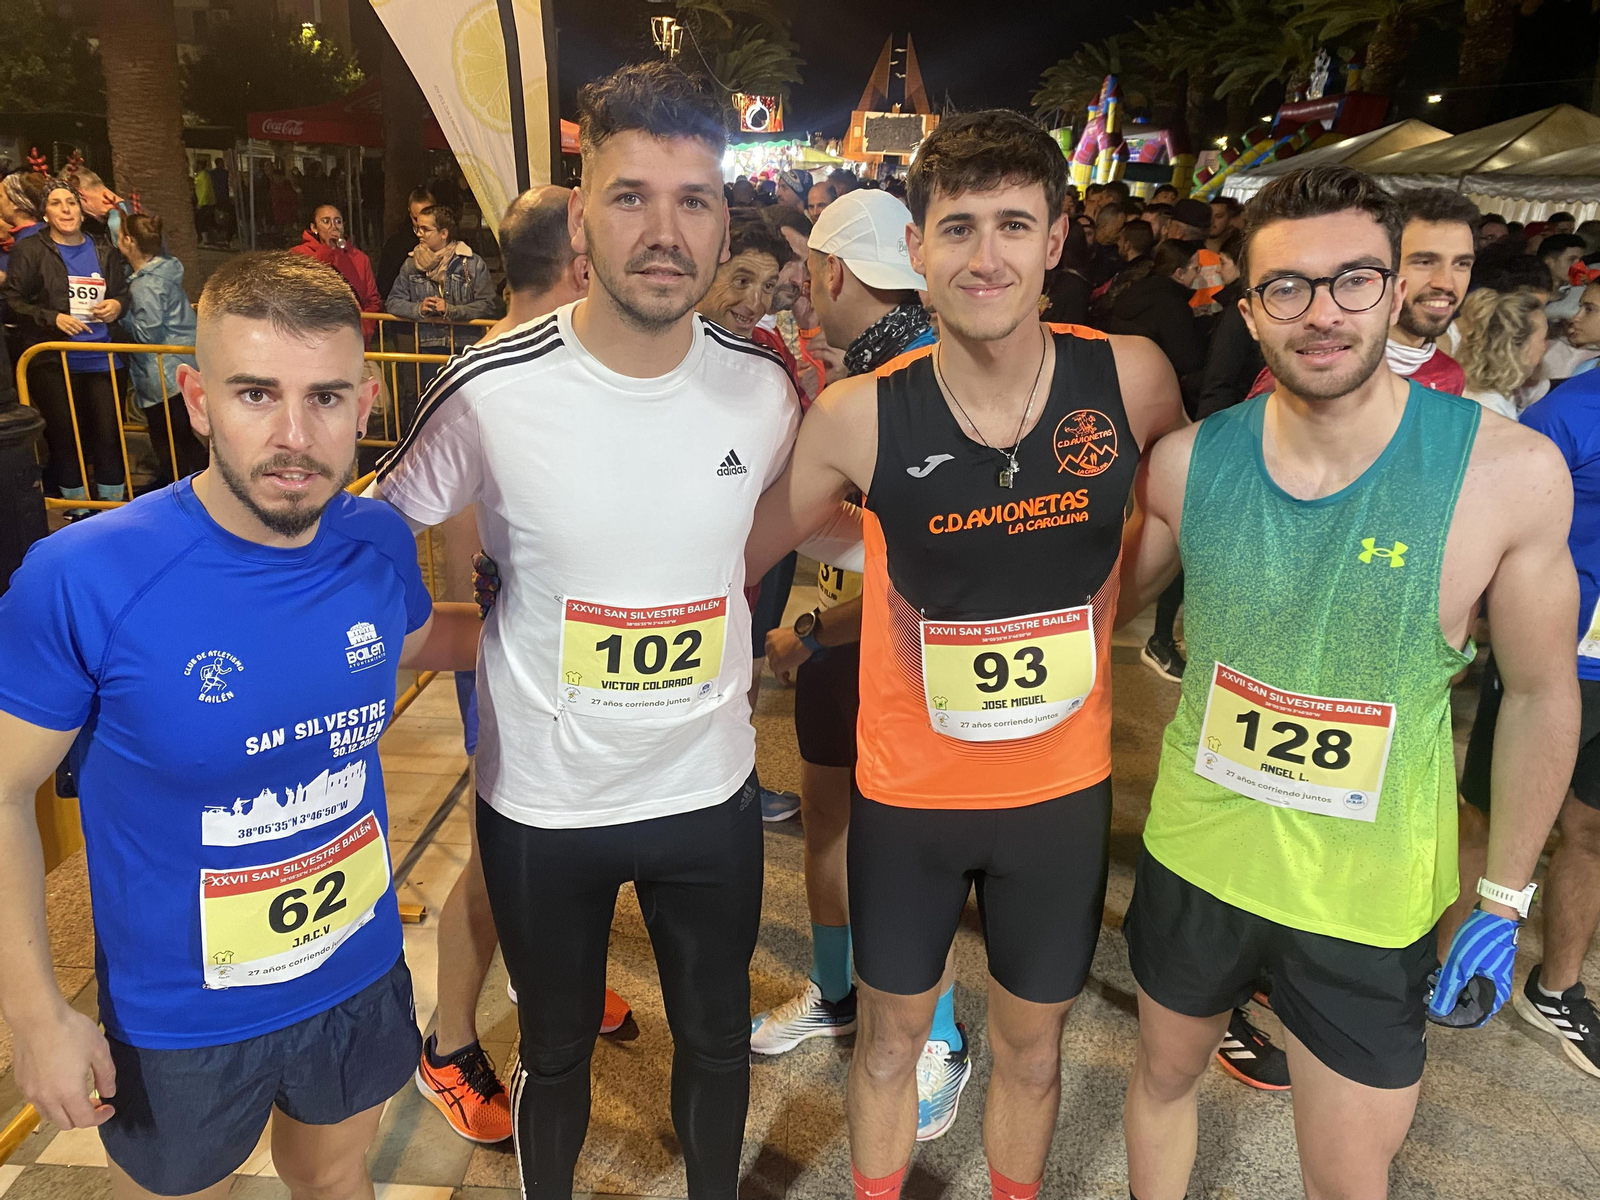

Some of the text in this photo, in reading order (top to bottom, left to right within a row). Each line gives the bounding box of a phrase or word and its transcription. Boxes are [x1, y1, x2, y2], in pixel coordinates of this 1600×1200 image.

[716, 465, 748, 477] adidas
[1008, 511, 1089, 535] LA CAROLINA
[571, 600, 720, 620] XXVII SAN SILVESTRE BAILÉN
[929, 612, 1081, 636] XXVII SAN SILVESTRE BAILÉN
[183, 650, 245, 676] CLUB DE ATLETISMO
[595, 629, 703, 675] 102
[973, 646, 1048, 694] 93
[601, 676, 693, 691] VICTOR COLORADO
[1221, 670, 1382, 717] XXVII SAN SILVESTRE BAILÉN
[198, 690, 235, 704] BAILÉN
[603, 700, 623, 708] años
[625, 699, 665, 707] corriendo
[666, 697, 691, 707] juntos
[981, 694, 1047, 710] JOSE MIGUEL
[245, 699, 386, 755] SAN SILVESTRE
[972, 719, 992, 728] años
[994, 715, 1034, 728] corriendo
[1034, 712, 1059, 724] juntos
[329, 718, 385, 749] BAILEN
[1235, 709, 1353, 770] 128
[1225, 769, 1236, 777] 27
[1236, 774, 1256, 786] años
[1257, 782, 1301, 798] corriendo
[1301, 792, 1332, 803] juntos
[1299, 772, 1309, 782] L.
[211, 822, 372, 887] XXVII SAN SILVESTRE BAILÉN
[268, 870, 347, 934] 62
[292, 924, 331, 948] J.A.C.V
[248, 969, 260, 977] 27
[262, 963, 287, 975] años
[288, 945, 331, 968] corriendo
